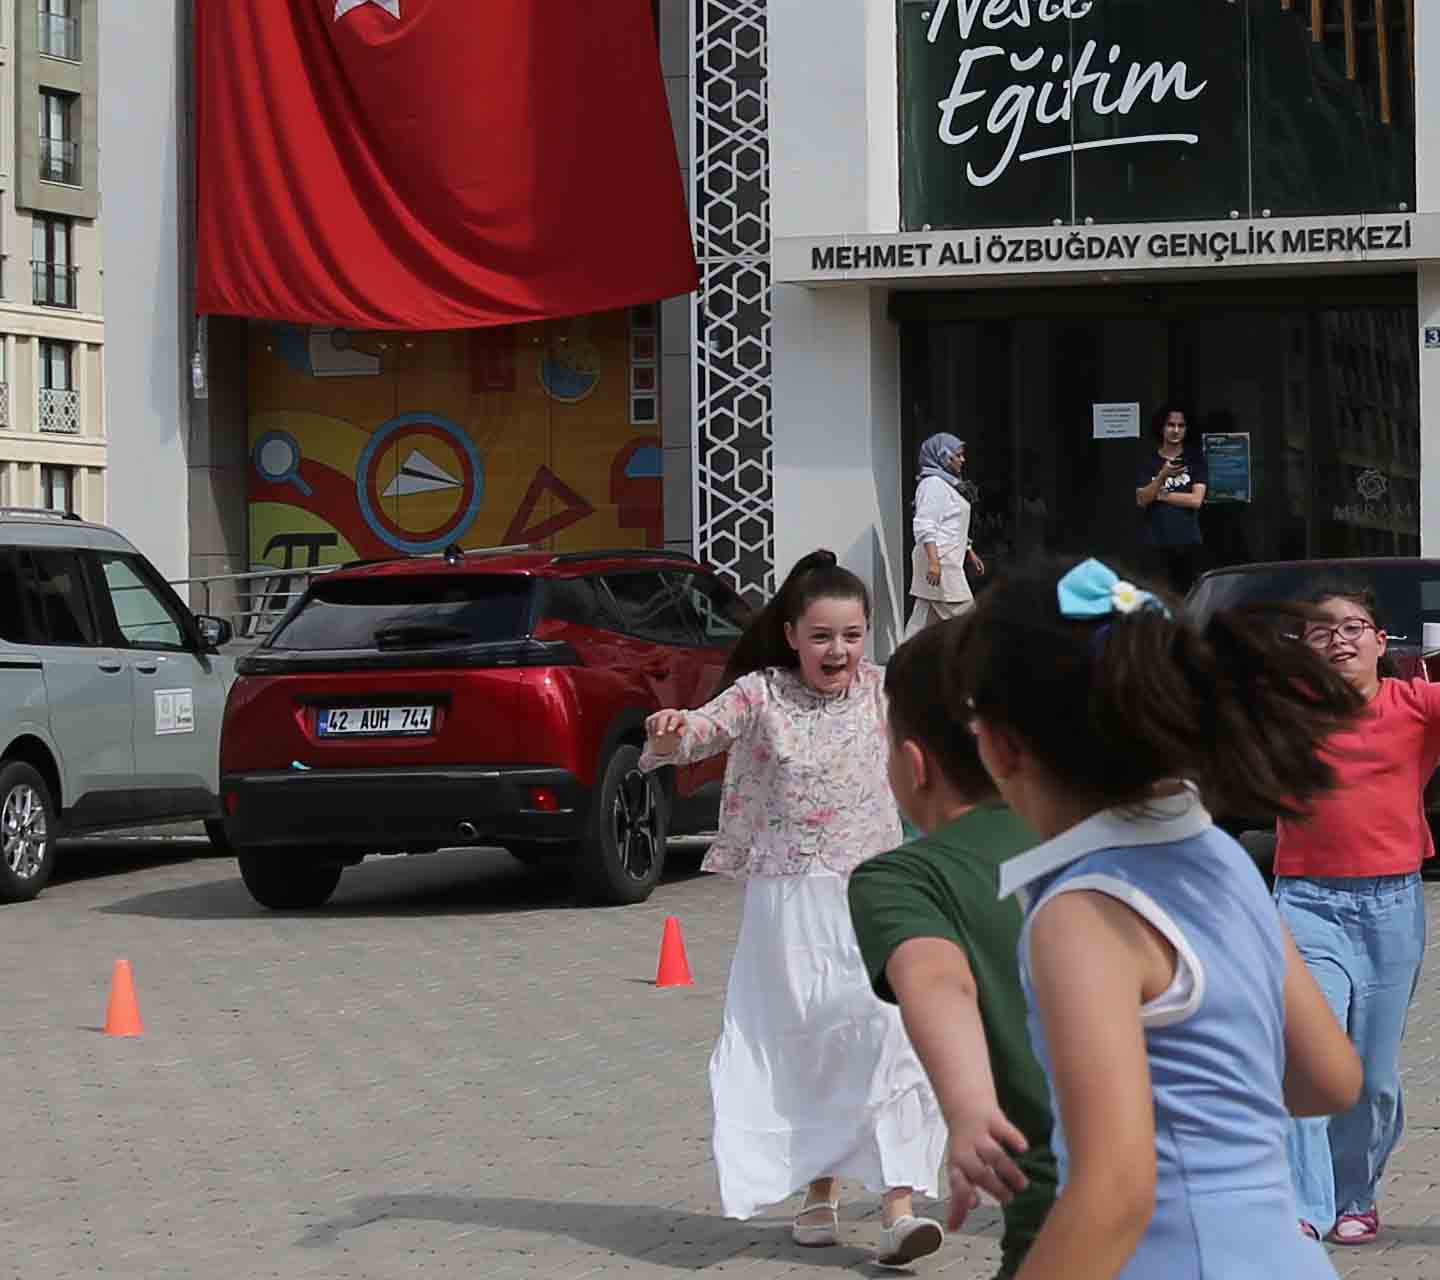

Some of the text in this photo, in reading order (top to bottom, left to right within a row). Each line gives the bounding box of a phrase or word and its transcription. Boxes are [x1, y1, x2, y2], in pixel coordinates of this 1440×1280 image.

[937, 38, 1209, 187] Eğitim
[811, 220, 1412, 270] MEHMET ALİ ÖZBUĞDAY GENÇLİK MERKEZİ
[329, 708, 430, 730] 42 AUH 744
